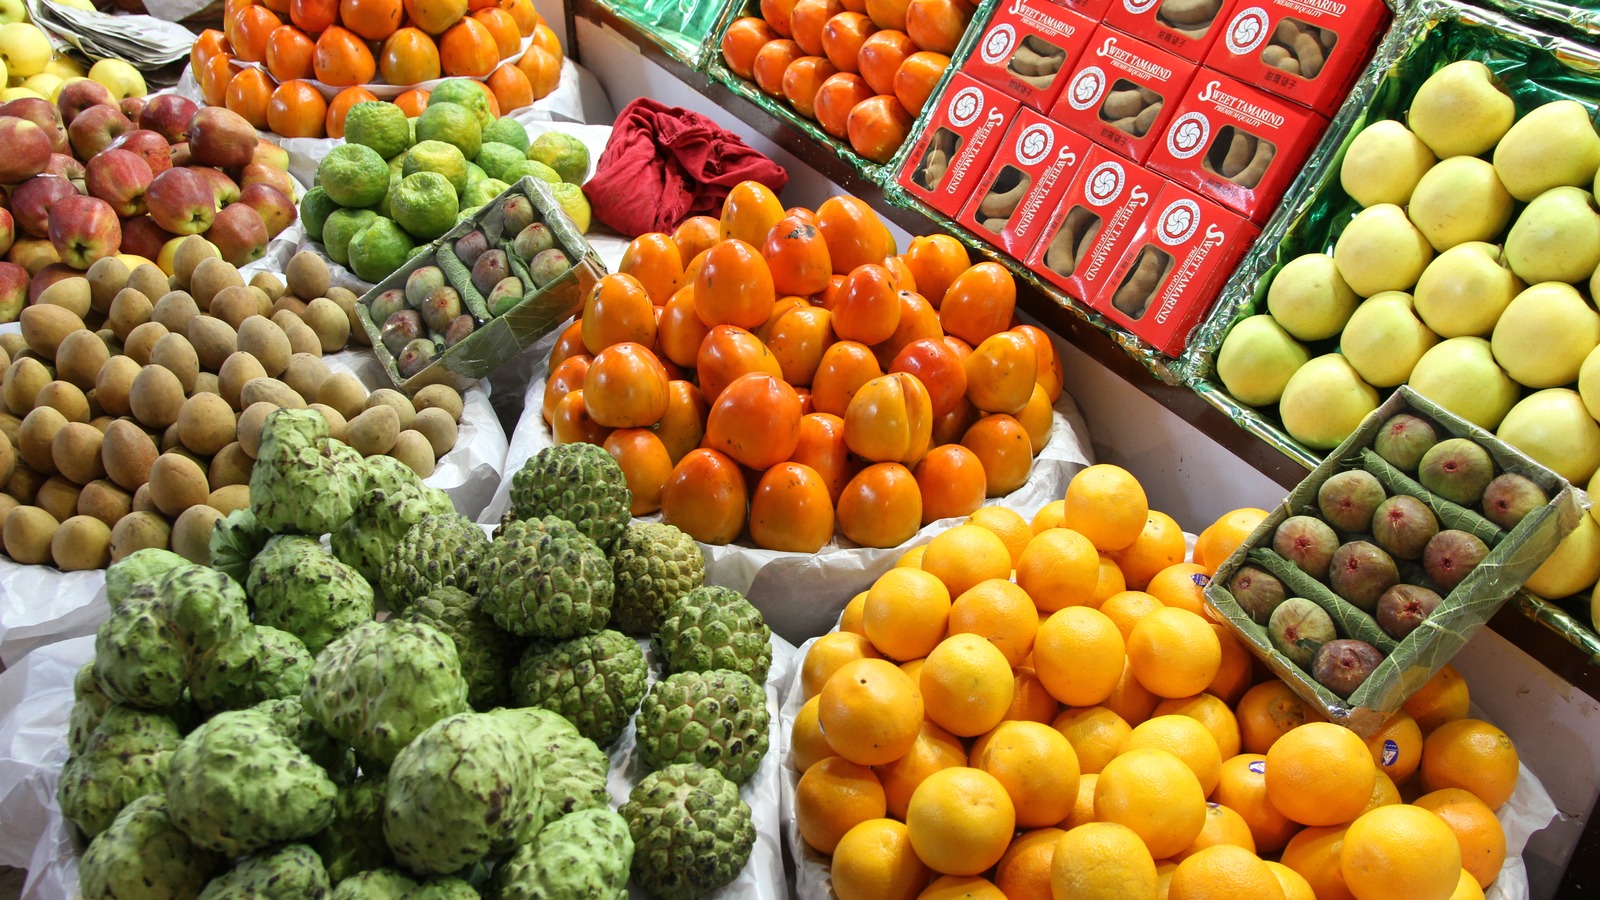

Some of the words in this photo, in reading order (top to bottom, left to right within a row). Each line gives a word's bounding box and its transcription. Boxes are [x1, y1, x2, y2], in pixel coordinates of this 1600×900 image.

[1008, 0, 1040, 19] SWEET
[1038, 13, 1076, 36] TAMARIND
[1020, 18, 1041, 30] PREMIUM
[1038, 26, 1058, 37] QUALITY
[1298, 6, 1323, 18] QUALITY
[1096, 37, 1132, 61] SWEET
[1132, 56, 1172, 80] TAMARIND
[1110, 60, 1134, 73] PREMIUM
[1131, 69, 1152, 81] QUALITY
[1198, 80, 1238, 107] SWEET
[1237, 100, 1284, 126] TAMARIND
[1214, 105, 1240, 118] PREMIUM
[1237, 114, 1262, 128] QUALITY
[966, 126, 982, 152] PREMIUM
[976, 107, 1004, 148] SWEET
[948, 148, 979, 194] TAMARIND
[952, 149, 968, 173] QUALITY
[1046, 146, 1076, 189] SWEET
[1034, 166, 1052, 194] PREMIUM
[1016, 188, 1050, 236] TAMARIND
[1020, 190, 1038, 216] QUALITY
[1120, 185, 1148, 230] SWEET
[1106, 206, 1123, 236] PREMIUM
[1086, 229, 1122, 281] TAMARIND
[1090, 232, 1110, 259] QUALITY
[1193, 224, 1224, 270] SWEET
[1178, 246, 1197, 278] PREMIUM
[1156, 270, 1194, 324] TAMARIND
[1161, 274, 1182, 300] QUALITY
